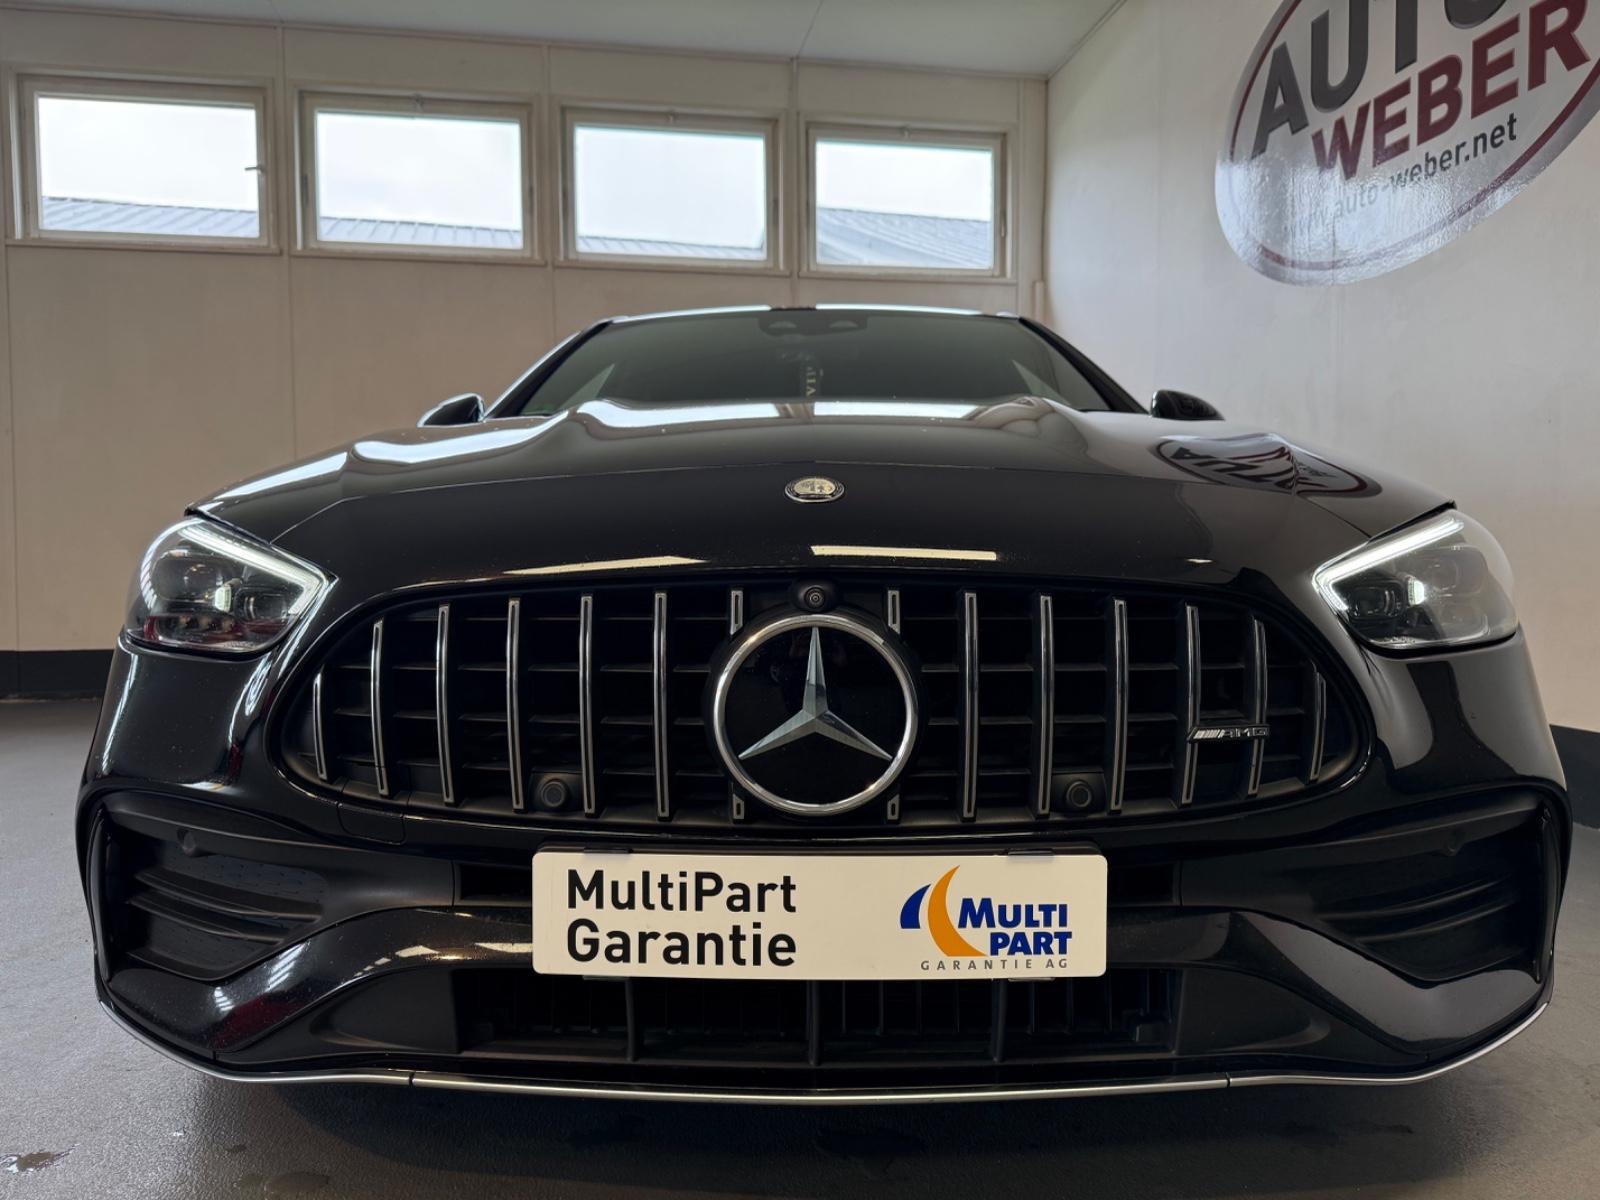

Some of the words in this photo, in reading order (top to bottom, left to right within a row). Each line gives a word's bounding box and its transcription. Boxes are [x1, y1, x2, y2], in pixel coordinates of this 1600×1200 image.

[1251, 0, 1508, 159] AUT
[1312, 0, 1591, 181] WEBER
[567, 869, 796, 913] MultiPart
[567, 918, 797, 967] Garantie
[920, 959, 1032, 971] GARANTIE
[1045, 958, 1068, 969] AG
[989, 931, 1072, 956] PART
